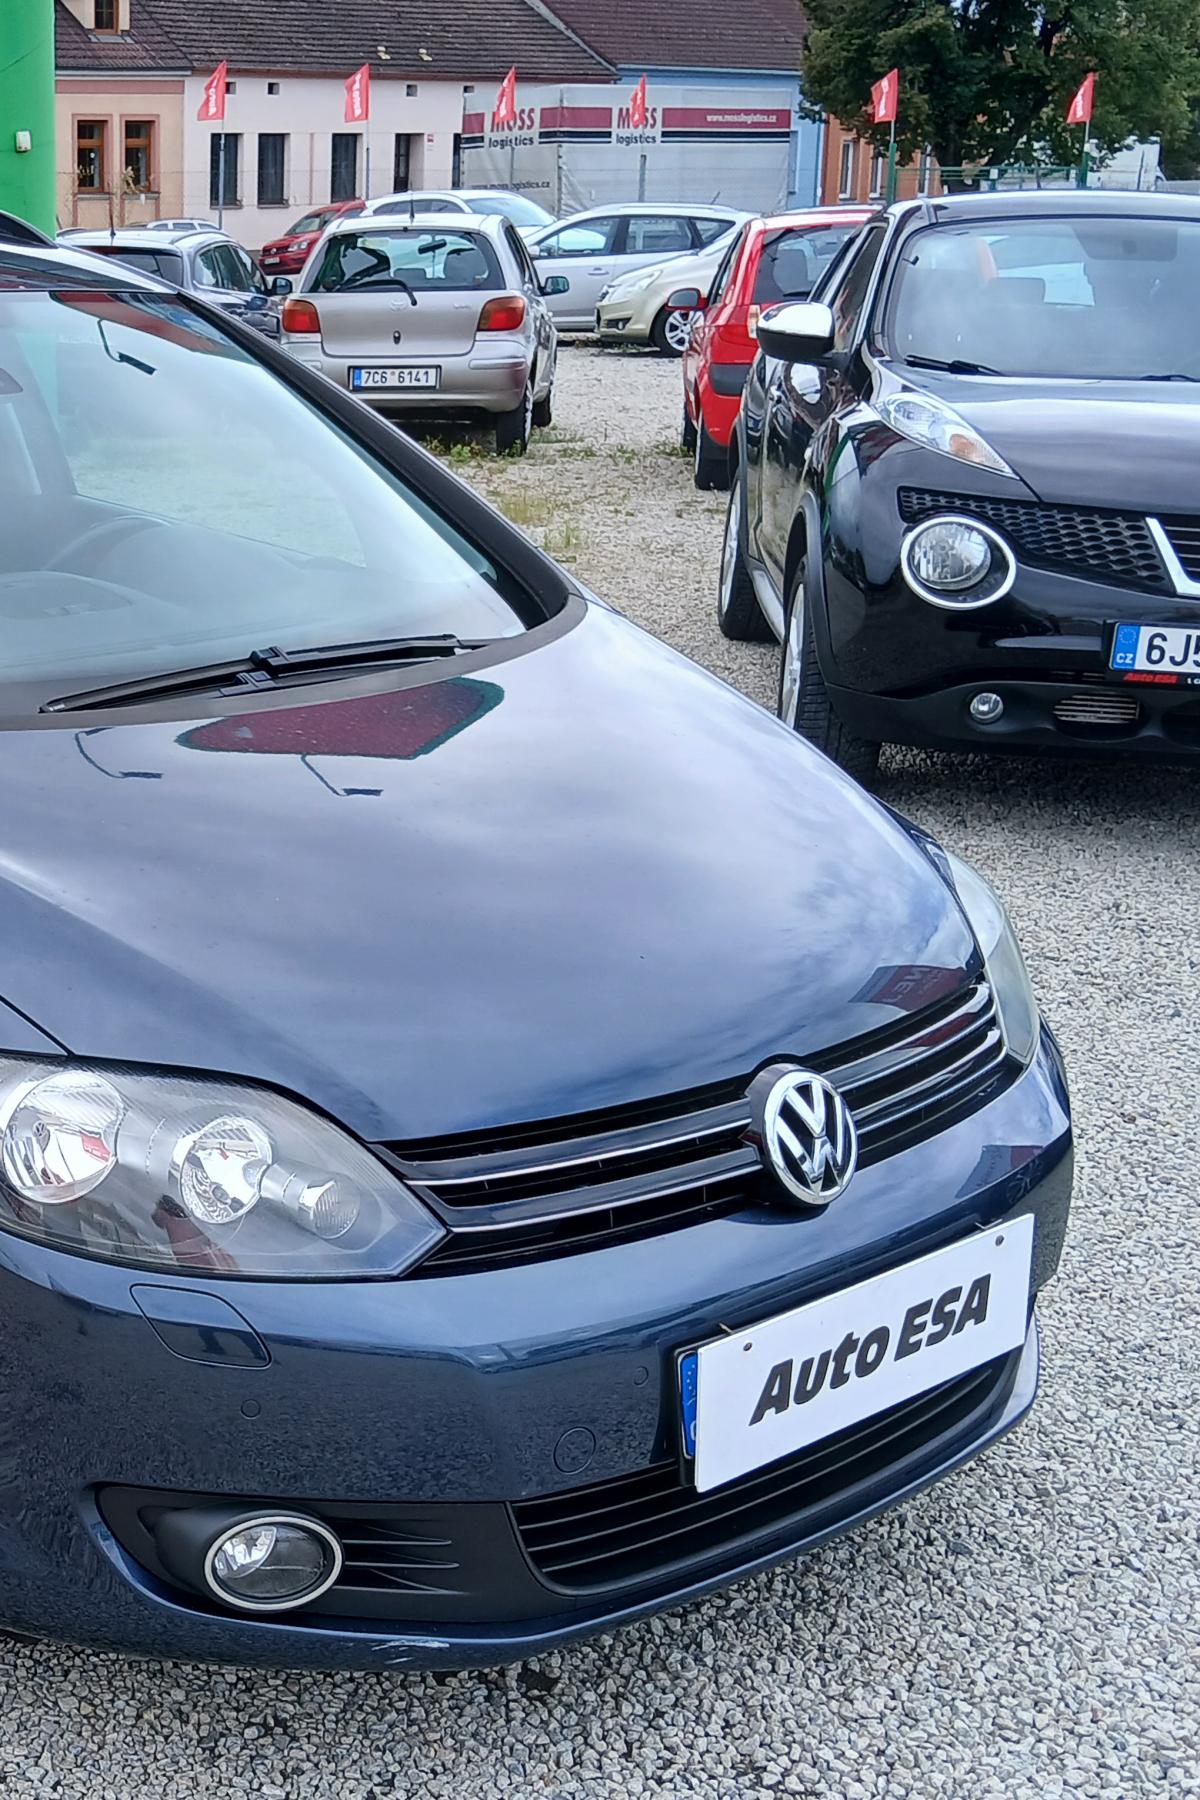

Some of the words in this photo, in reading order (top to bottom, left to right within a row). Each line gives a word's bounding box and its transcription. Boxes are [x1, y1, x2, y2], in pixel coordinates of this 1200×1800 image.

[488, 135, 534, 150] logistics
[616, 133, 657, 146] logistics
[364, 370, 387, 384] 7C6
[398, 370, 430, 384] 6141
[1116, 653, 1133, 663] CZ
[748, 1325, 890, 1426] Auto
[894, 1273, 991, 1361] ESA
